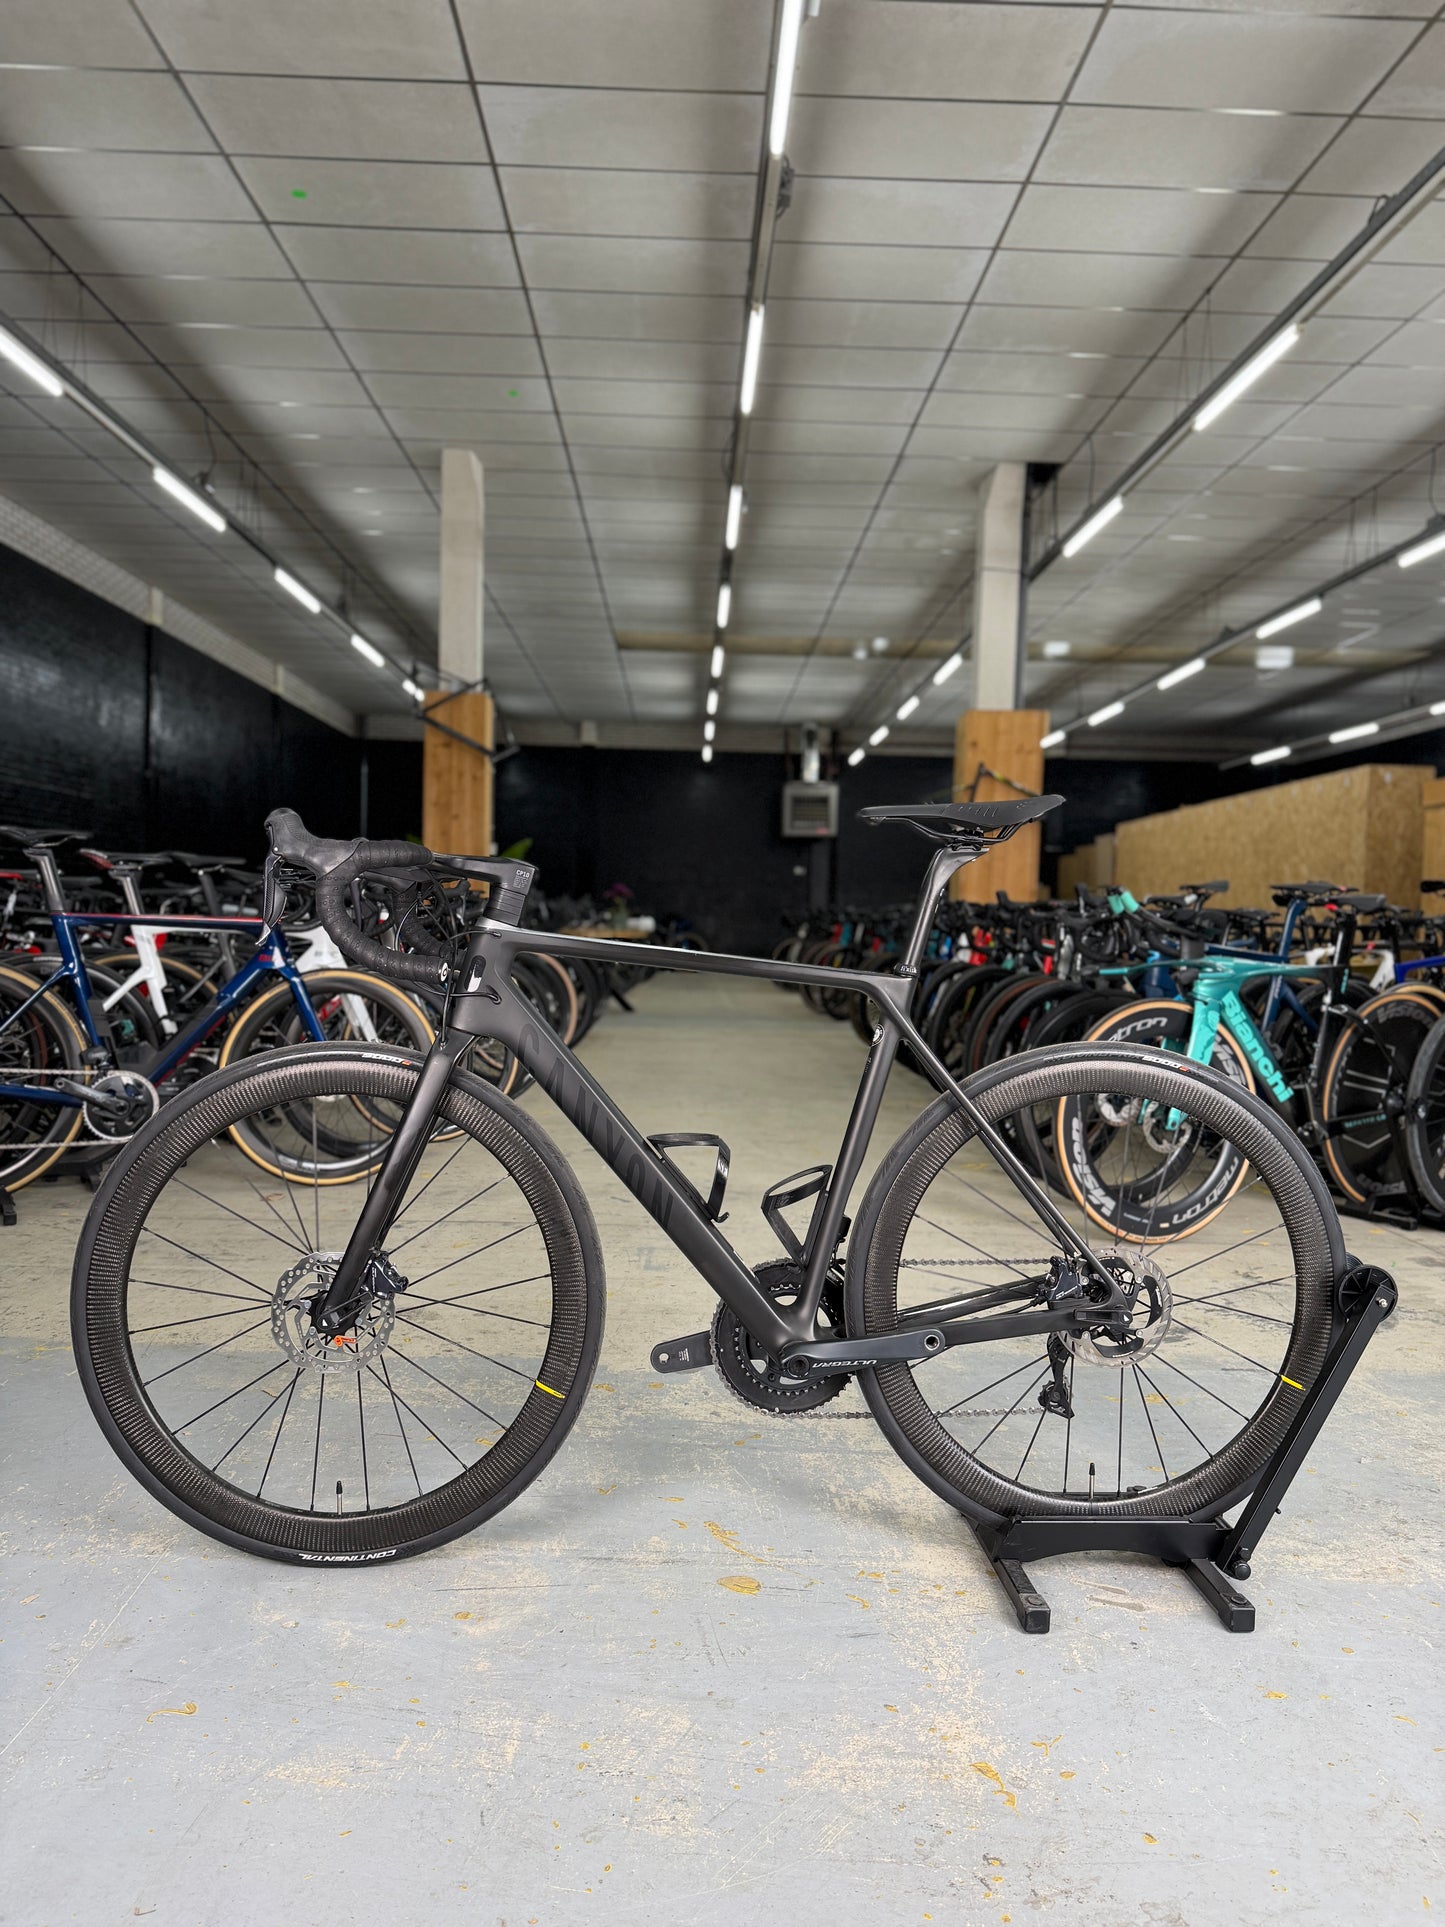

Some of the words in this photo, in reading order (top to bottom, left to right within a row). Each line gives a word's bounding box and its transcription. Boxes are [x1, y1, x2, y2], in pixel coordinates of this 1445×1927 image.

[1222, 990, 1294, 1103] Bianchi
[518, 1023, 674, 1229] CANYON
[812, 1359, 877, 1368] ULTEGRA
[298, 1549, 397, 1562] CONTINENTAL
